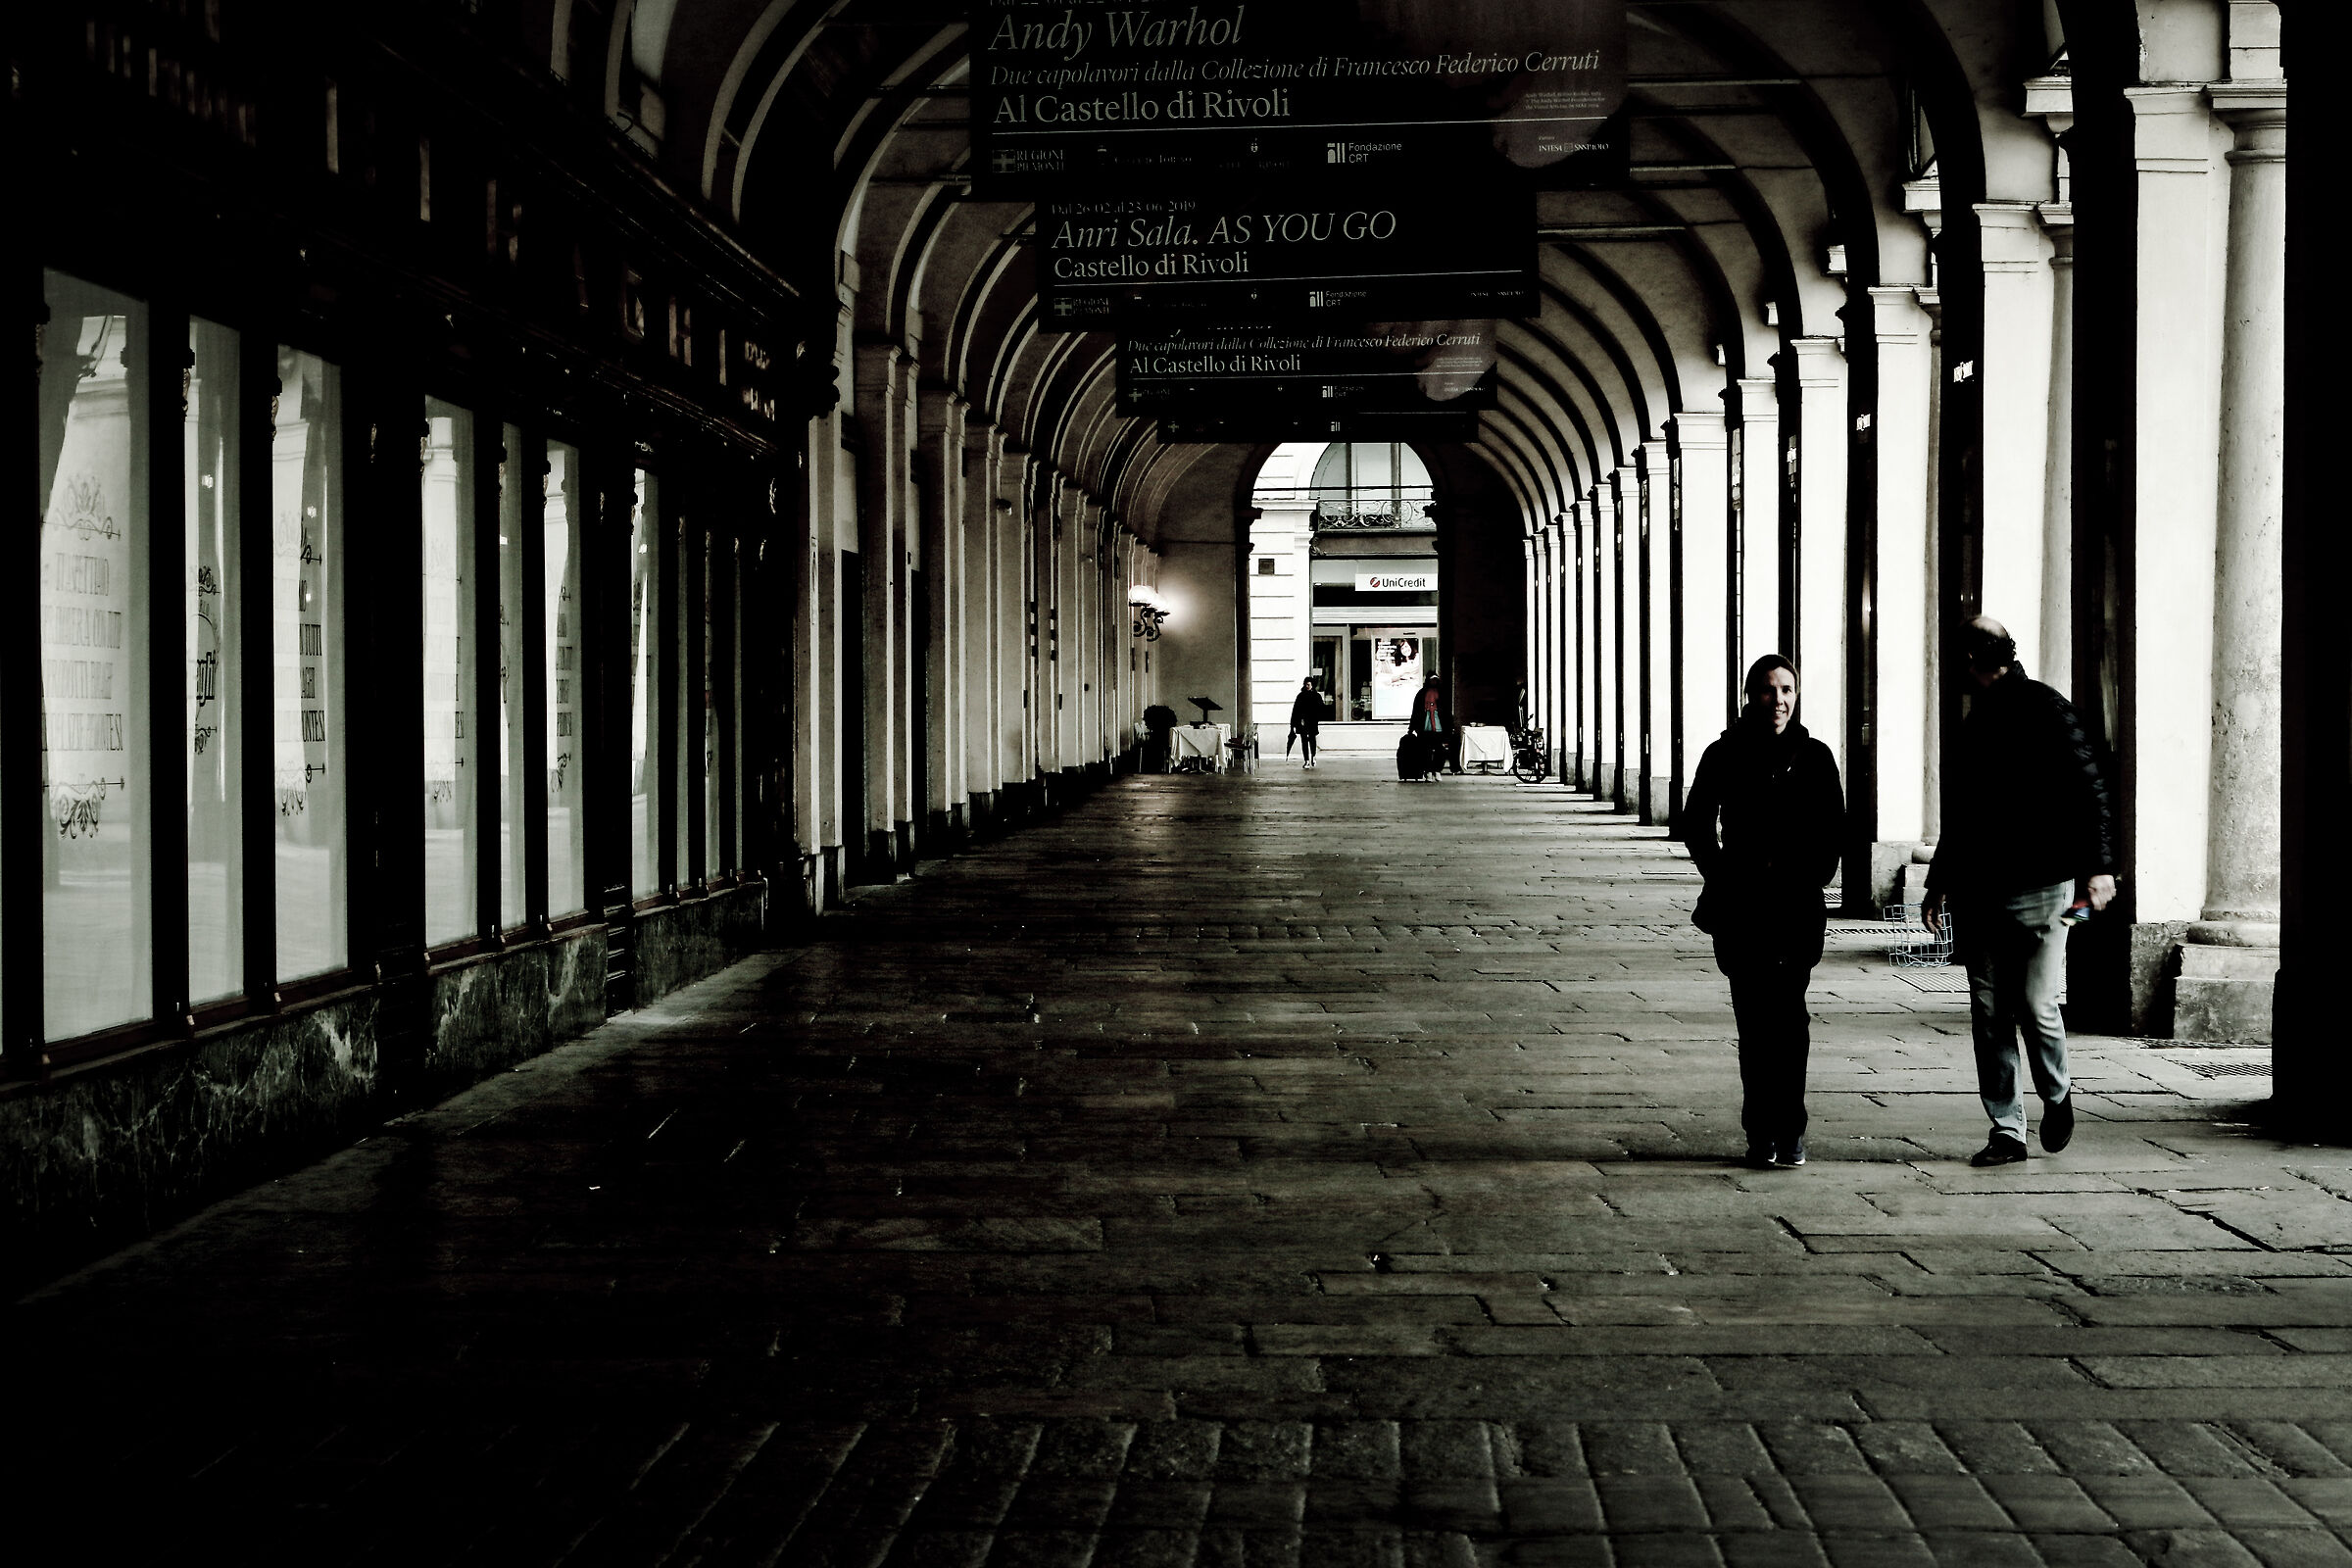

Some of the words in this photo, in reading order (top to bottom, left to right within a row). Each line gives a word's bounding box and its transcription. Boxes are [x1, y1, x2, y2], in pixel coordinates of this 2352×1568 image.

[988, 9, 1093, 62] Andy
[1105, 4, 1247, 48] Warhol
[991, 65, 1032, 85] Due
[1037, 62, 1140, 90] capolavori
[1201, 57, 1303, 81] Collezione
[1309, 55, 1329, 77] di
[1332, 55, 1431, 77] Francesco
[1435, 51, 1519, 75] Federico
[1524, 49, 1600, 73] Cerruti
[993, 94, 1027, 123] Al
[1034, 91, 1160, 122] Castello
[1166, 90, 1197, 119] di
[1202, 87, 1292, 119] Rivoli
[1348, 142, 1402, 153] Fondazione
[1348, 153, 1369, 165] CRT
[1051, 218, 1120, 248] Anri
[1127, 215, 1199, 247] Sala.
[1207, 211, 1252, 245] AS
[1262, 212, 1336, 244] YOU
[1343, 210, 1396, 240] GO
[1054, 253, 1151, 278] Castello
[1154, 252, 1177, 275] di
[1182, 250, 1250, 274] Rivoli
[1385, 334, 1434, 348] Federico
[1436, 332, 1481, 347] Cerruti
[1129, 356, 1150, 374] Al
[1152, 354, 1226, 374] Castello
[1229, 353, 1248, 372] di
[1250, 352, 1301, 371] Rivoli
[1382, 576, 1427, 588] UniCredit
